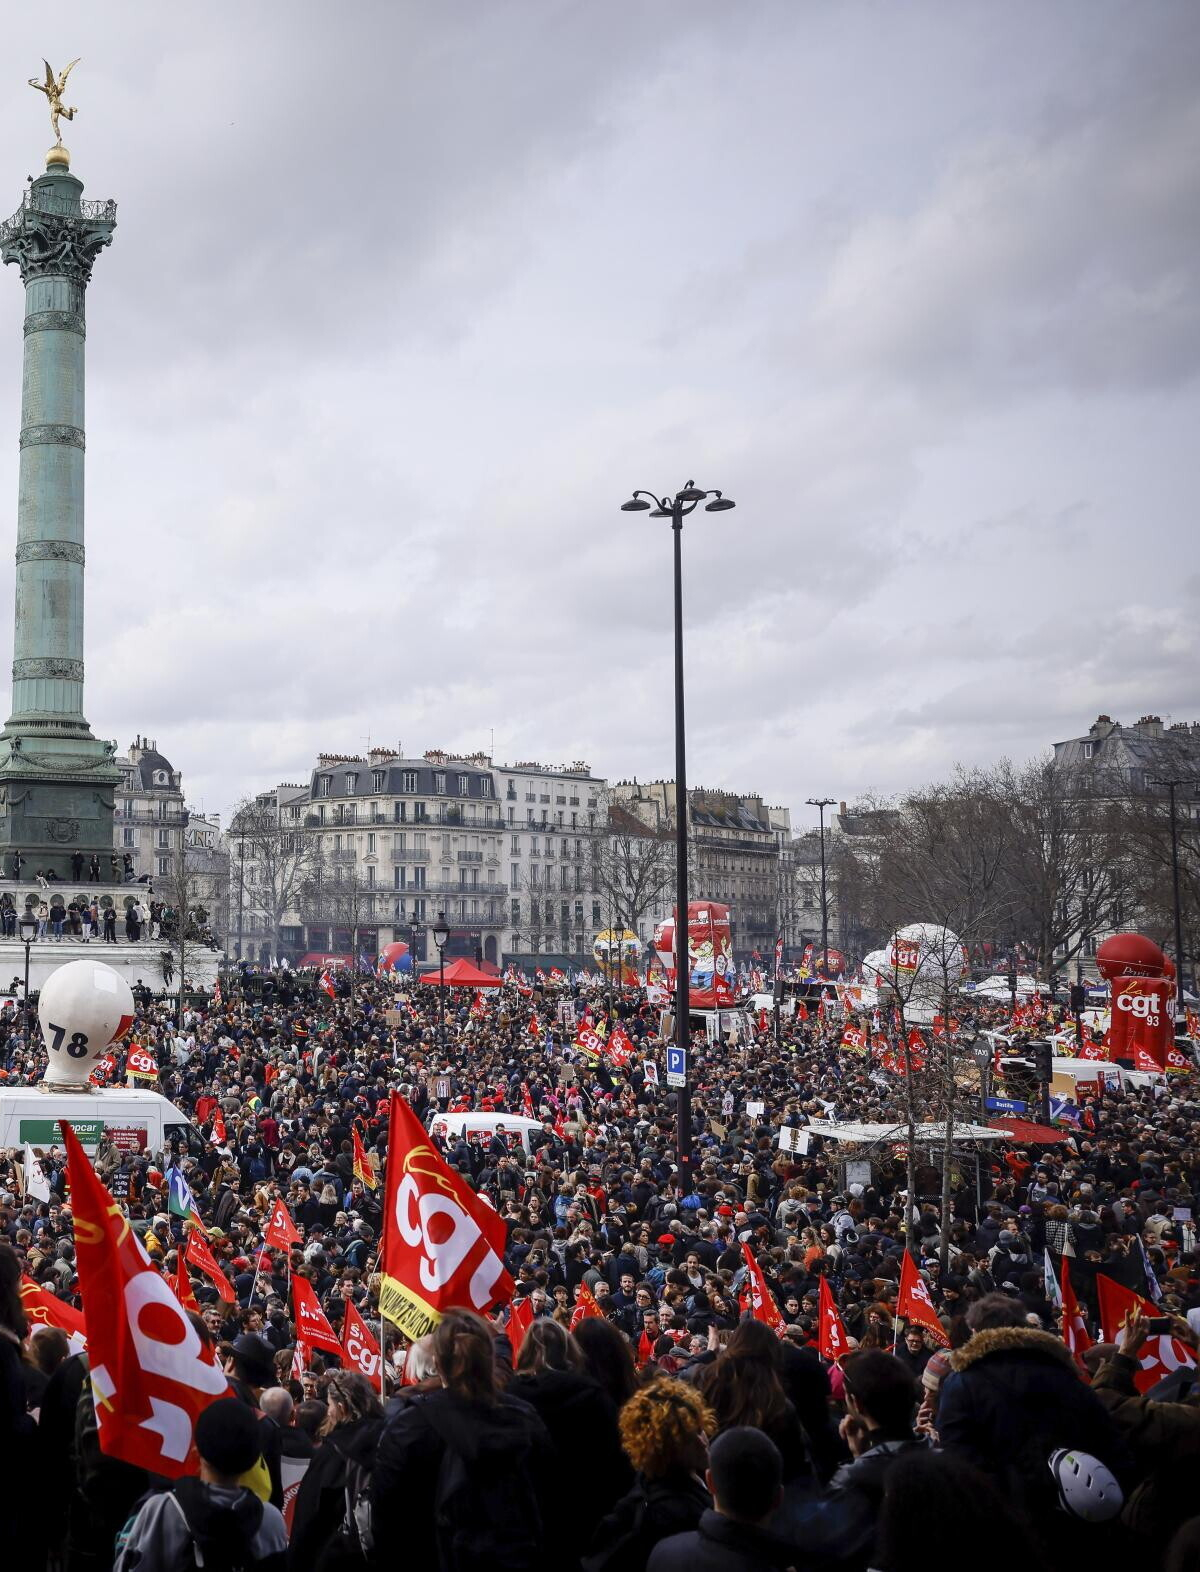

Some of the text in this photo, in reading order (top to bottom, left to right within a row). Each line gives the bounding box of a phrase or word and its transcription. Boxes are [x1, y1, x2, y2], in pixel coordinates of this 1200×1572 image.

[1117, 993, 1160, 1018] cgt
[1146, 1015, 1160, 1027] 93
[48, 1022, 89, 1058] 78
[100, 1060, 113, 1072] gt
[671, 1053, 680, 1069] P
[996, 1101, 1014, 1109] Bastille
